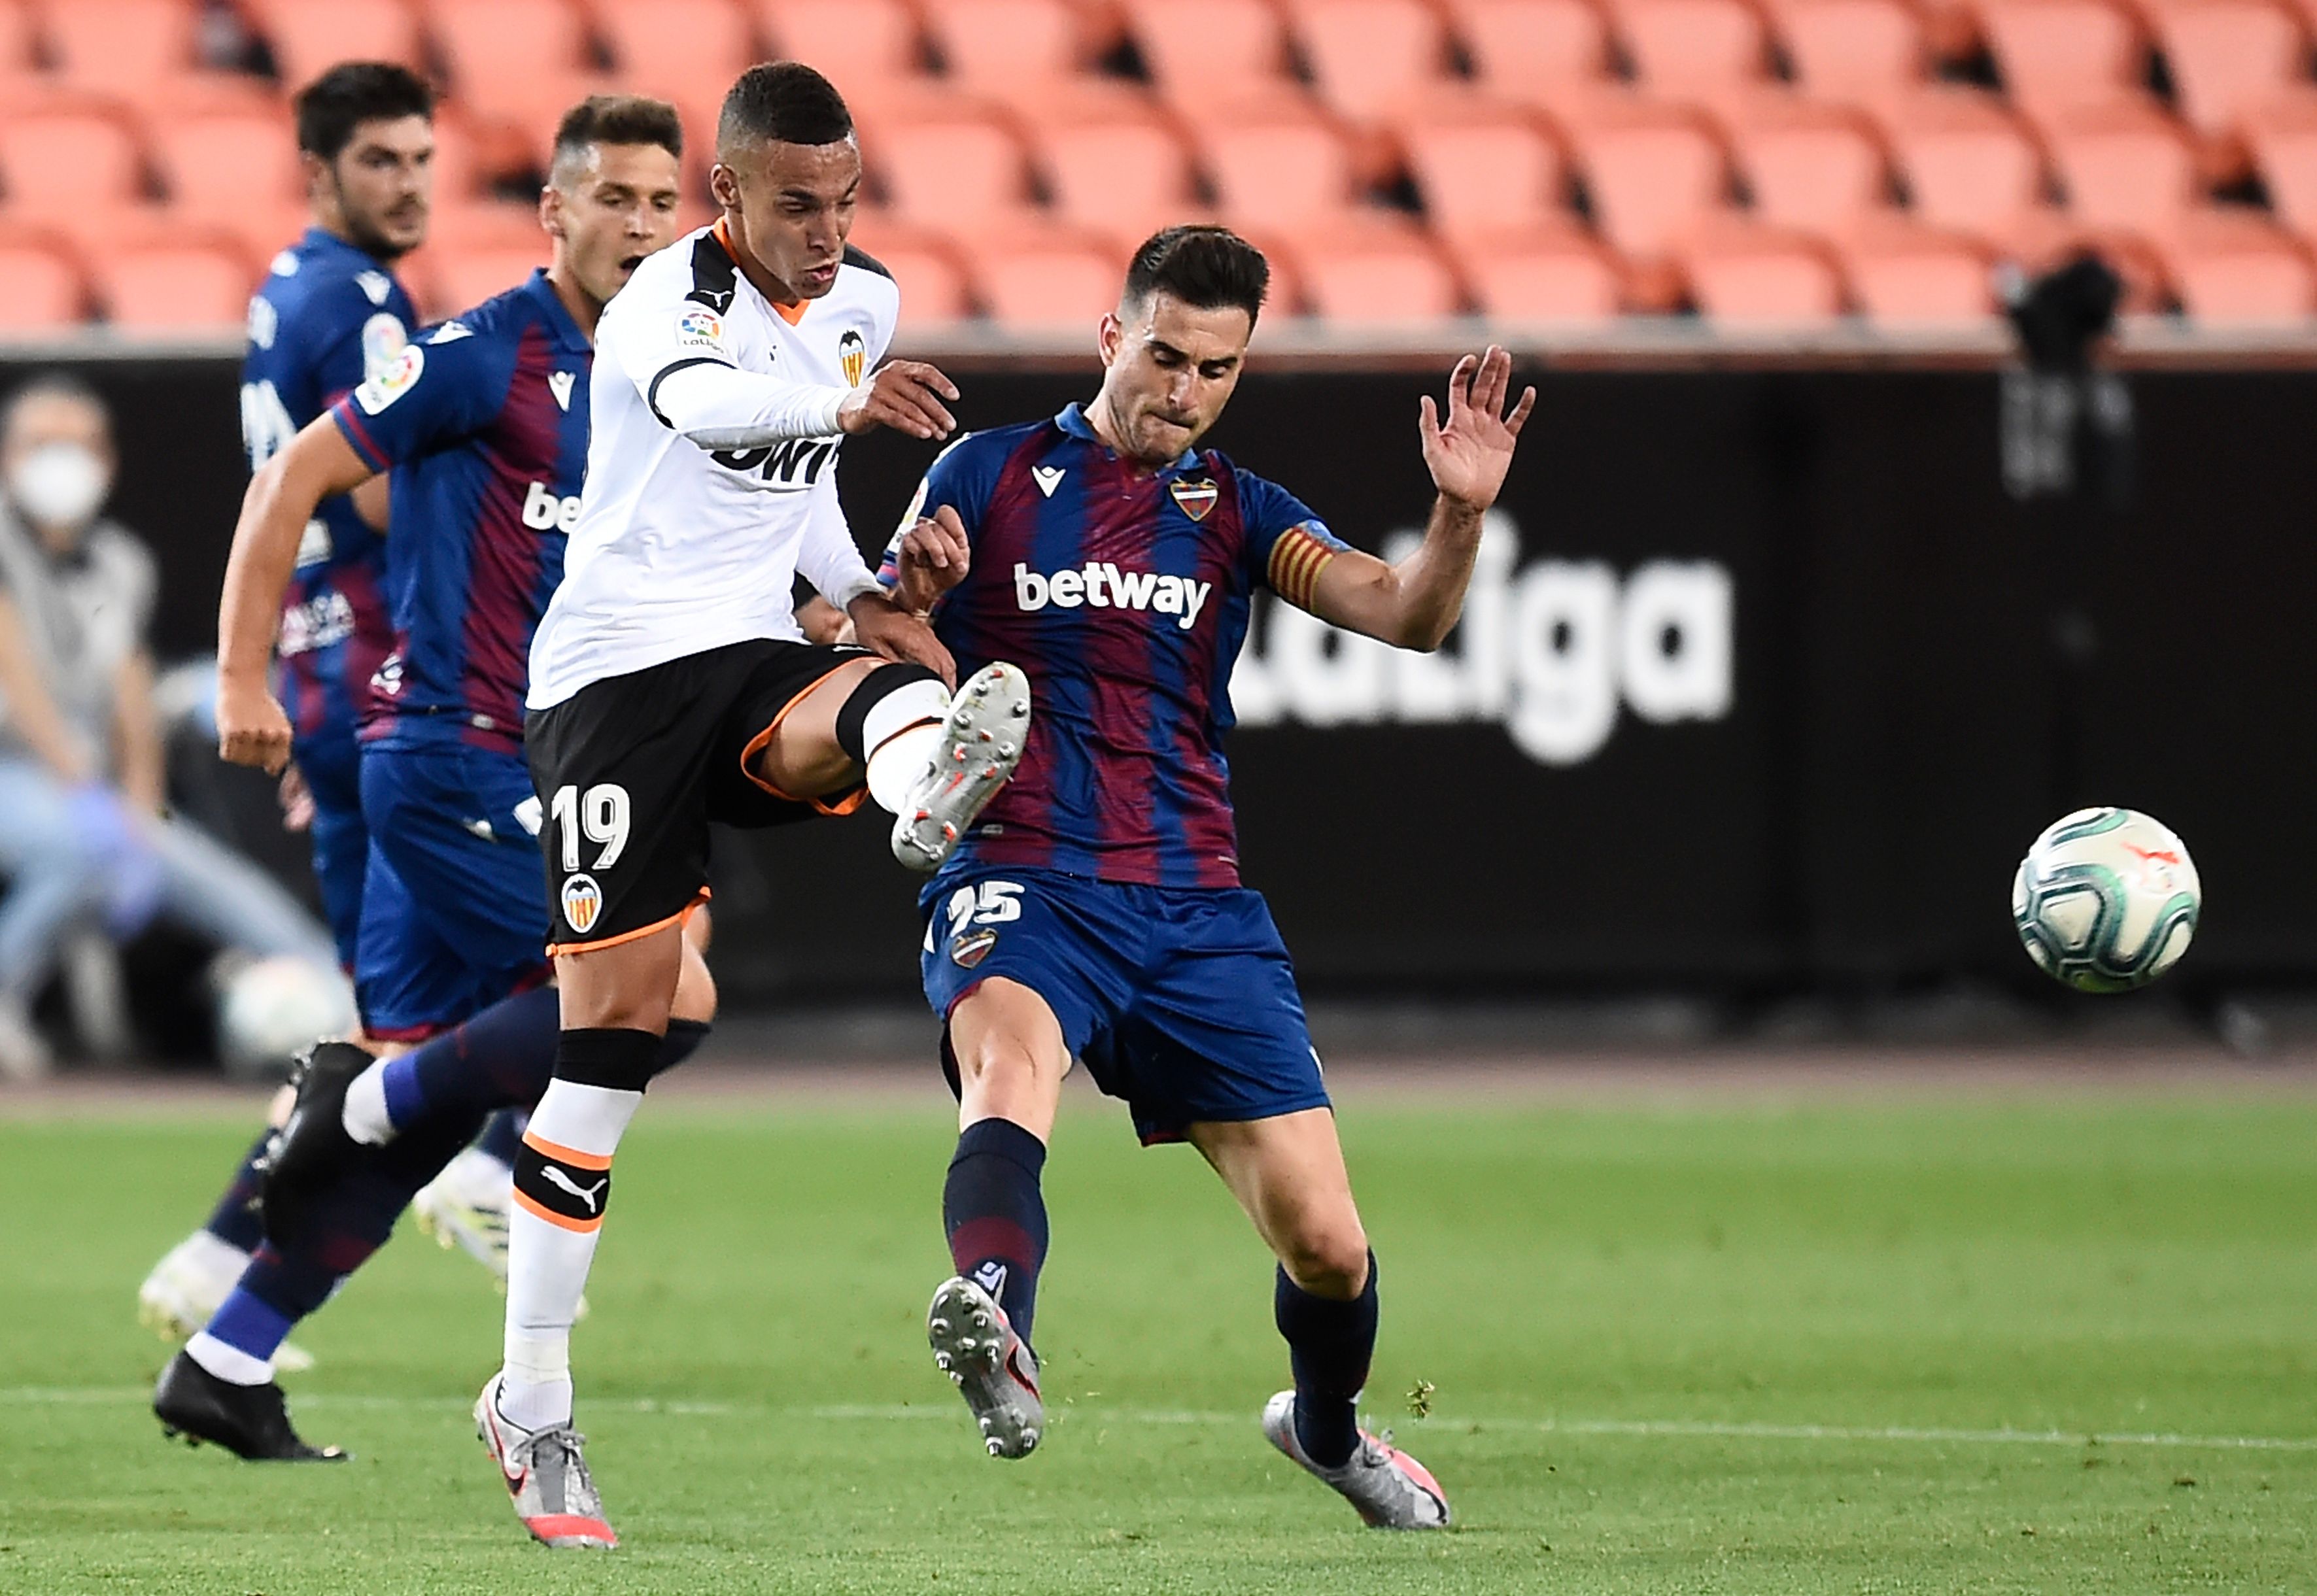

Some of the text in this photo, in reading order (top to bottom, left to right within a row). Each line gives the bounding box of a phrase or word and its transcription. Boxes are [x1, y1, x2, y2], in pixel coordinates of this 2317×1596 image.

[1014, 562, 1212, 630] betway
[551, 783, 630, 872] 19
[946, 881, 1025, 938] 15
